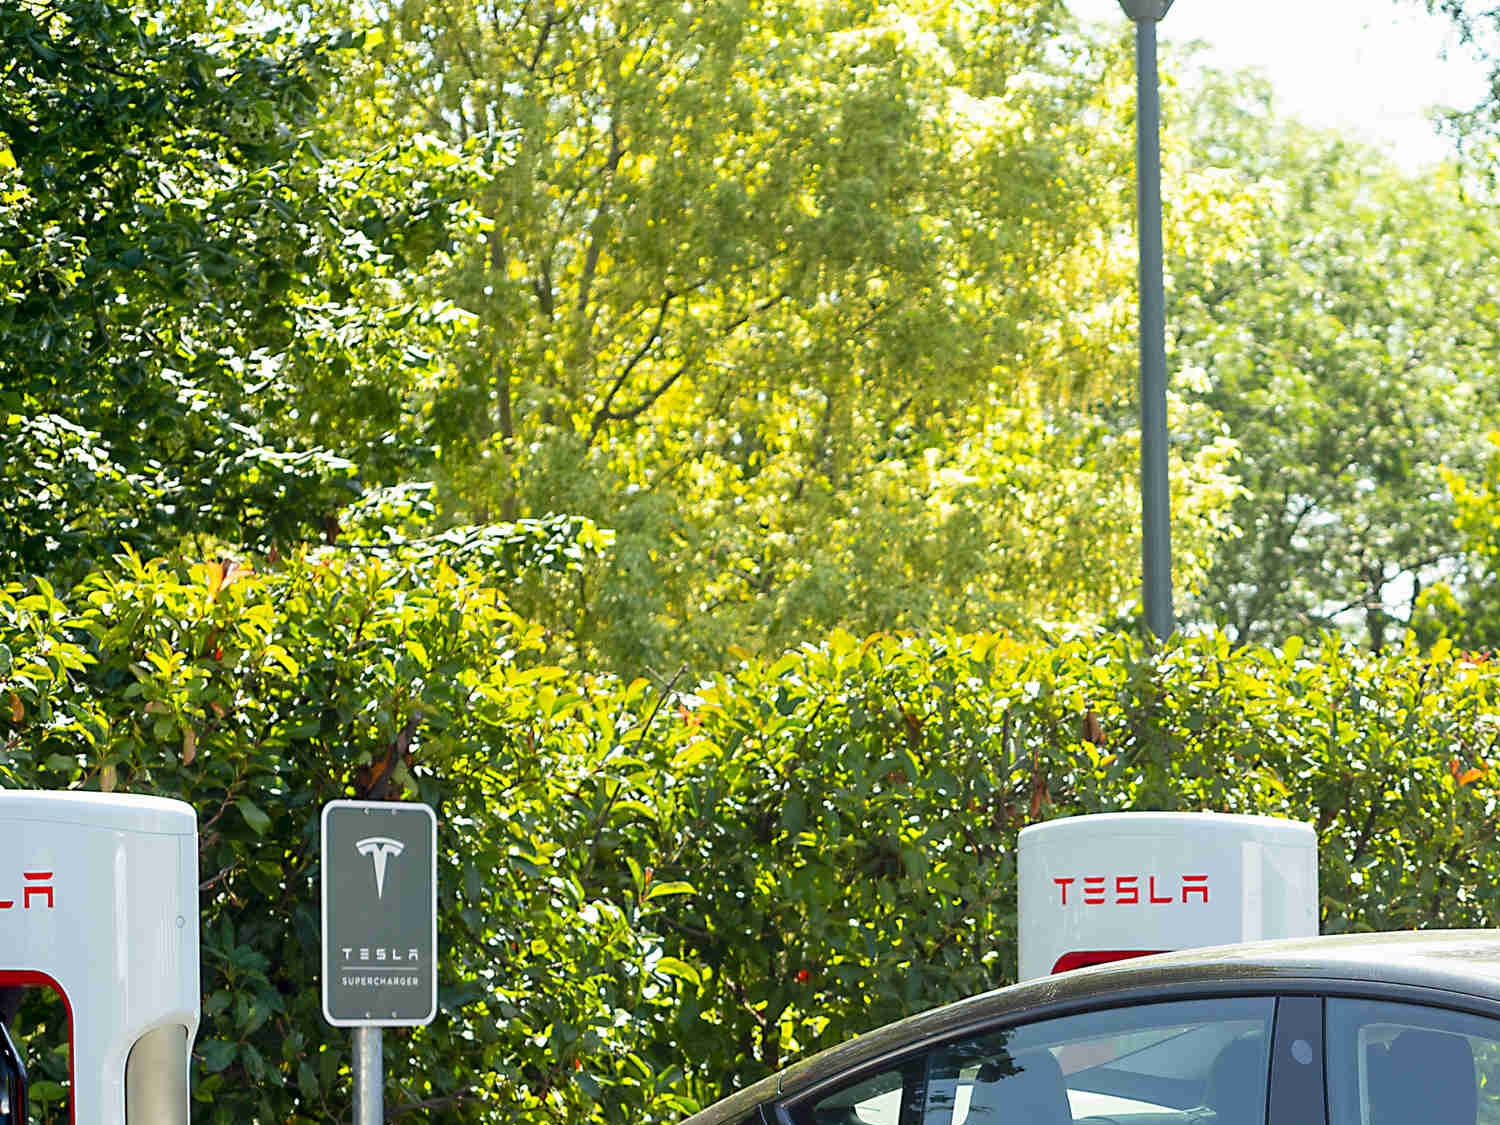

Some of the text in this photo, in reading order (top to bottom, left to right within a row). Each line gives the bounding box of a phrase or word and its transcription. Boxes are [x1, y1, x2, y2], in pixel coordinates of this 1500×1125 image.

[1053, 875, 1208, 904] TESLA
[341, 947, 419, 961] TESLA
[341, 976, 419, 987] SUPERCHARGER
